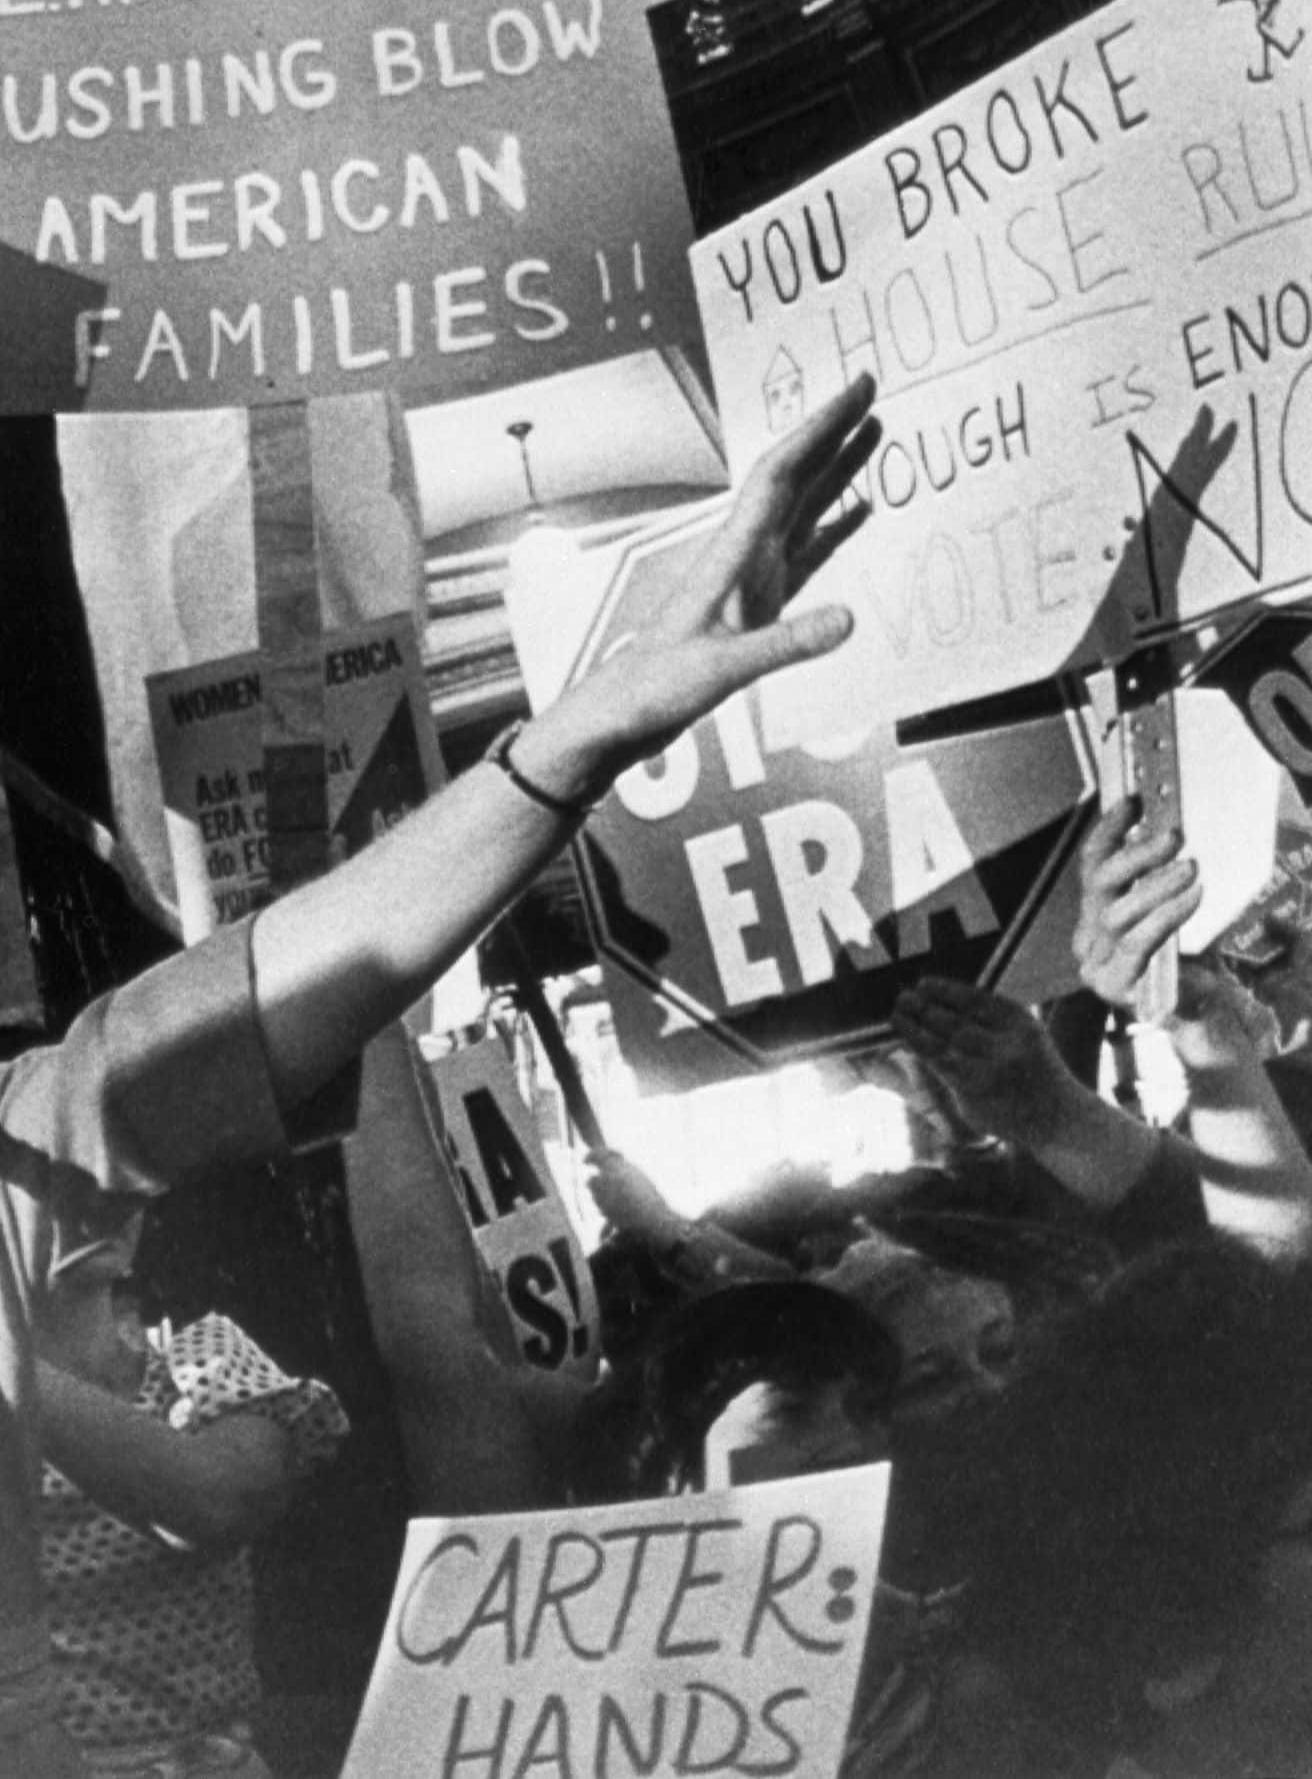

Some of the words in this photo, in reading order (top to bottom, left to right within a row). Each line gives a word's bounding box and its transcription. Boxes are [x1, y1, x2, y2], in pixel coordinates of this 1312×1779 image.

[35, 134, 528, 266] AMERICAN
[717, 189, 847, 322] YOU
[884, 22, 1149, 241] BROKE
[830, 169, 1129, 387] HOUSE
[1181, 98, 1312, 234] RU
[840, 380, 1031, 515] OUGH
[1086, 363, 1157, 428] IS
[1182, 281, 1312, 390] ENO
[199, 806, 248, 843] ERA
[206, 849, 237, 879] do
[242, 837, 273, 873] FO
[684, 759, 999, 1007] ERA
[396, 1514, 858, 1668] CARTER:
[443, 1682, 810, 1779] HANDS
